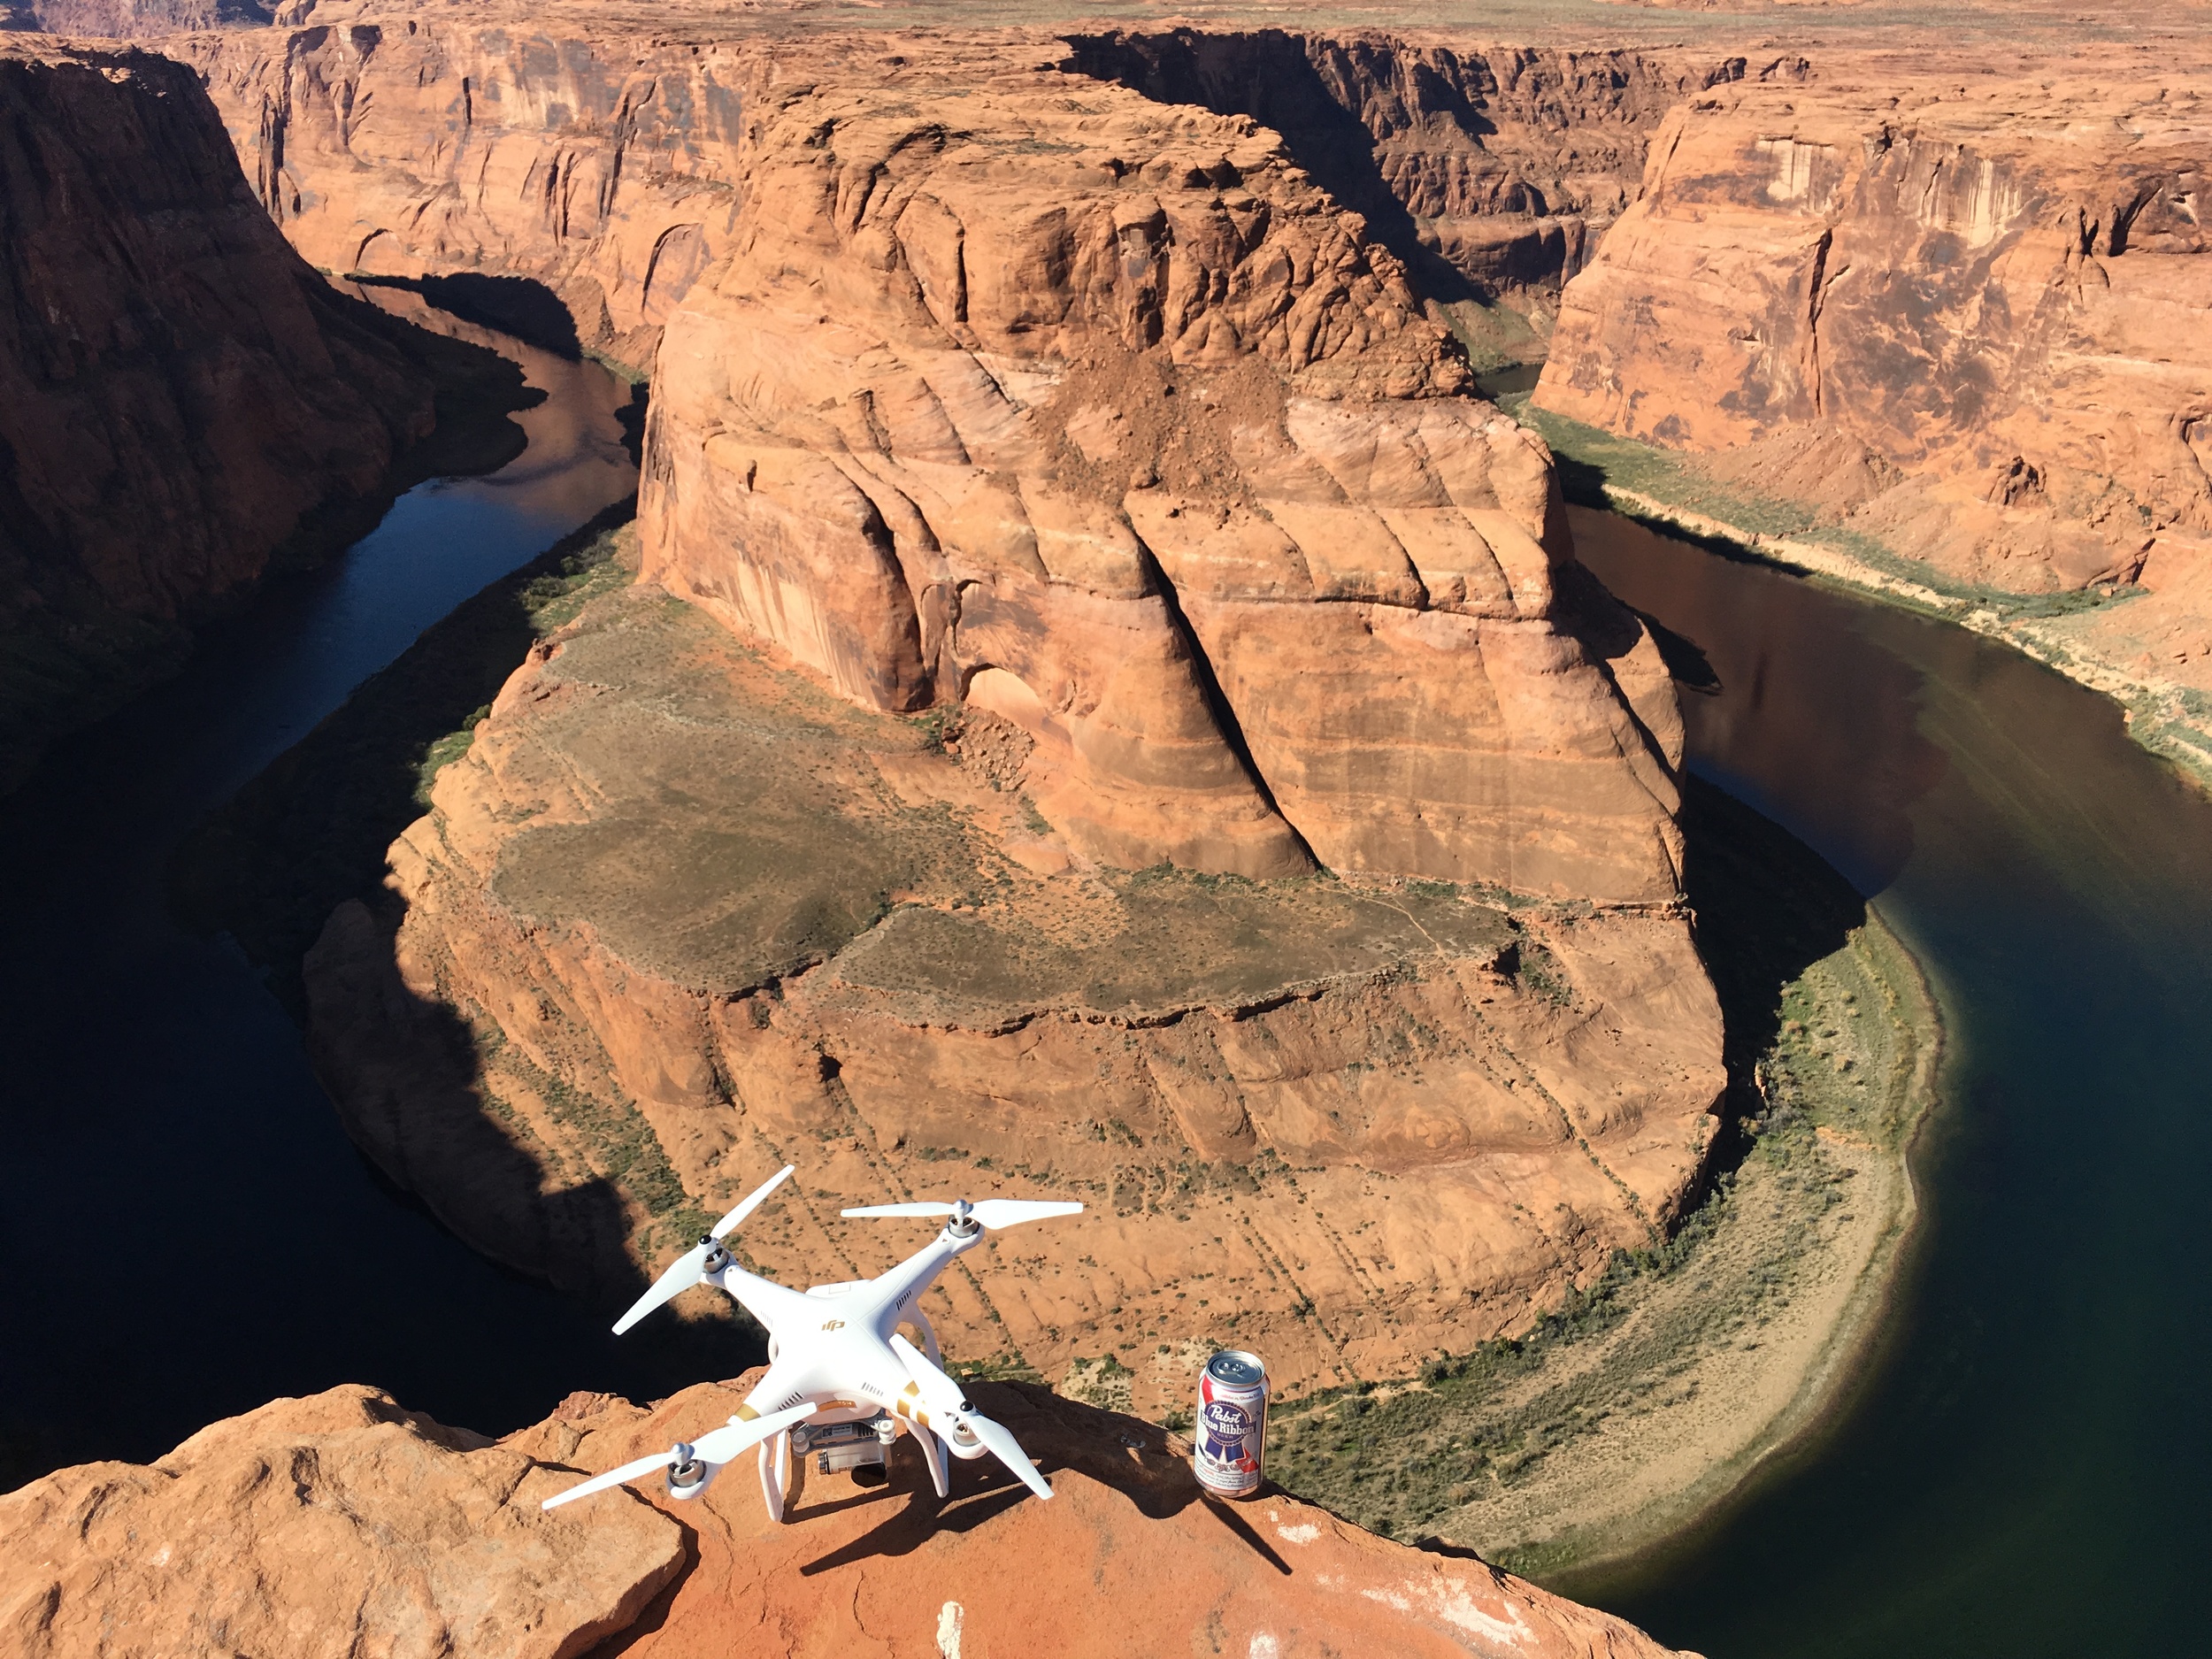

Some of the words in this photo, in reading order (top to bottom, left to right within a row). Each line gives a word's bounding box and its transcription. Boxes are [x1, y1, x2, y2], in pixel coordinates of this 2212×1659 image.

[1211, 1404, 1241, 1423] Pabst
[1201, 1413, 1218, 1431] Blue
[1219, 1422, 1254, 1435] Ribbon
